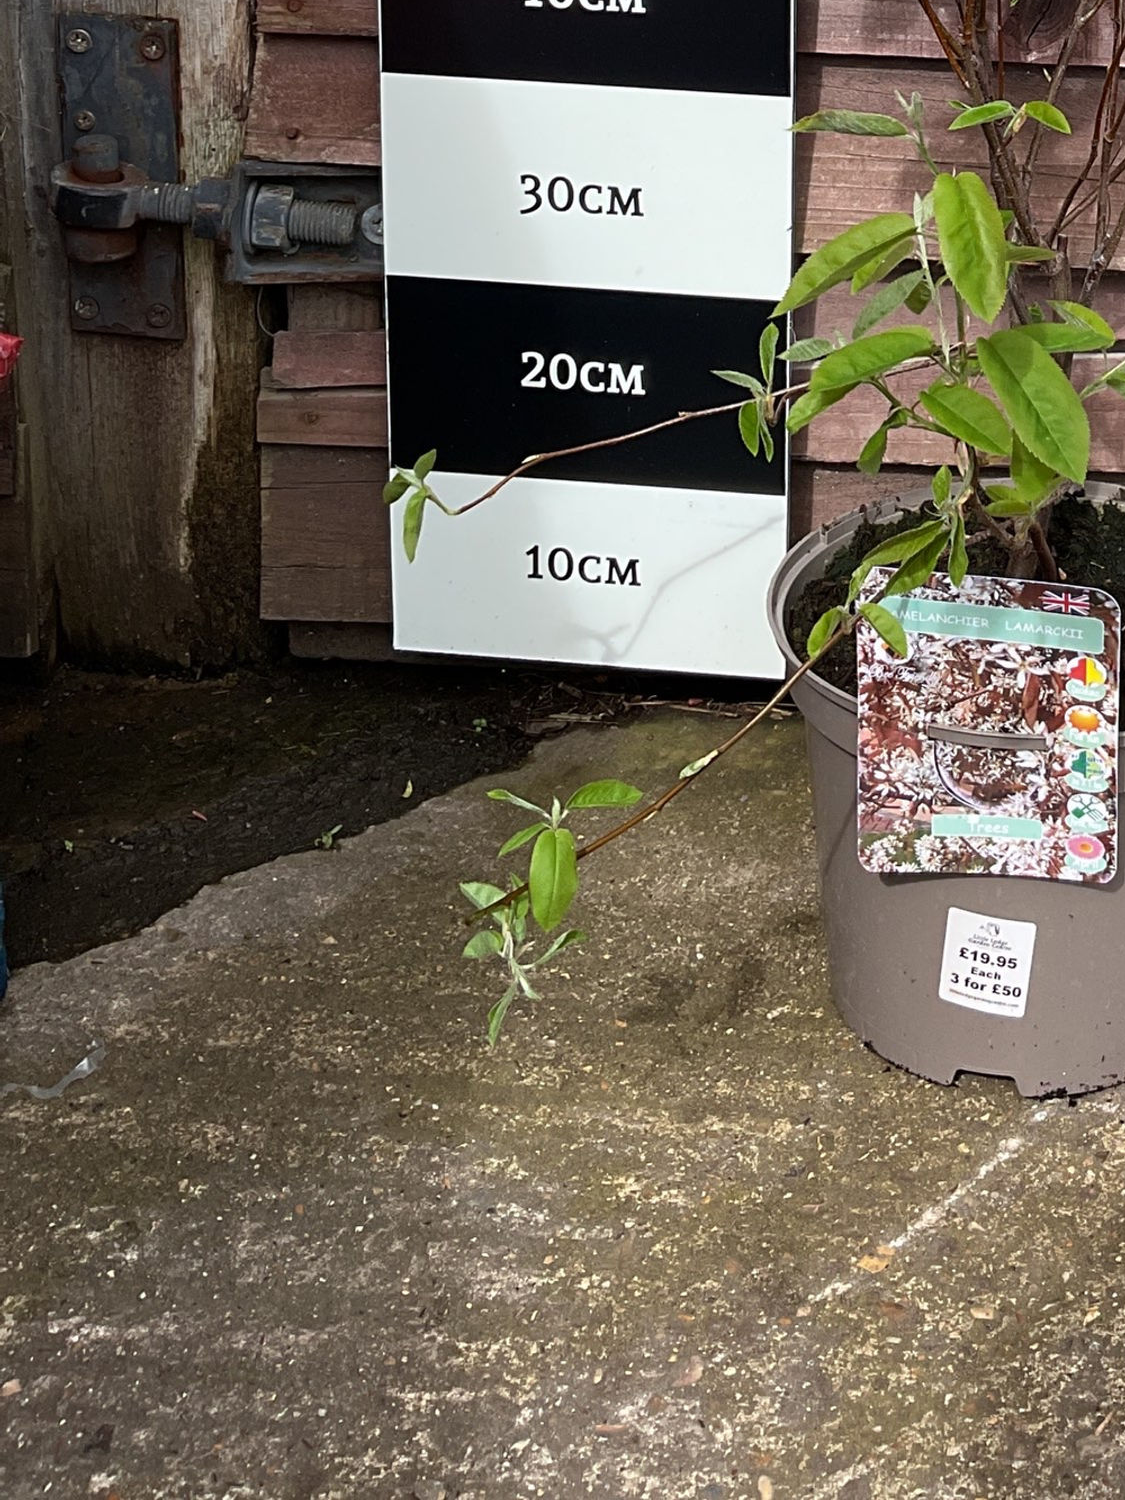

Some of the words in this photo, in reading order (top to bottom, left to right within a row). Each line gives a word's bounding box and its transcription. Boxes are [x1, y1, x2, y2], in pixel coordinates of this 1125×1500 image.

[1005, 620, 1084, 640] LAMARCKII
[959, 947, 1018, 970] £19.95
[970, 966, 1002, 981] Each
[950, 972, 960, 984] 3
[964, 977, 988, 992] for
[992, 983, 1022, 998] £50
